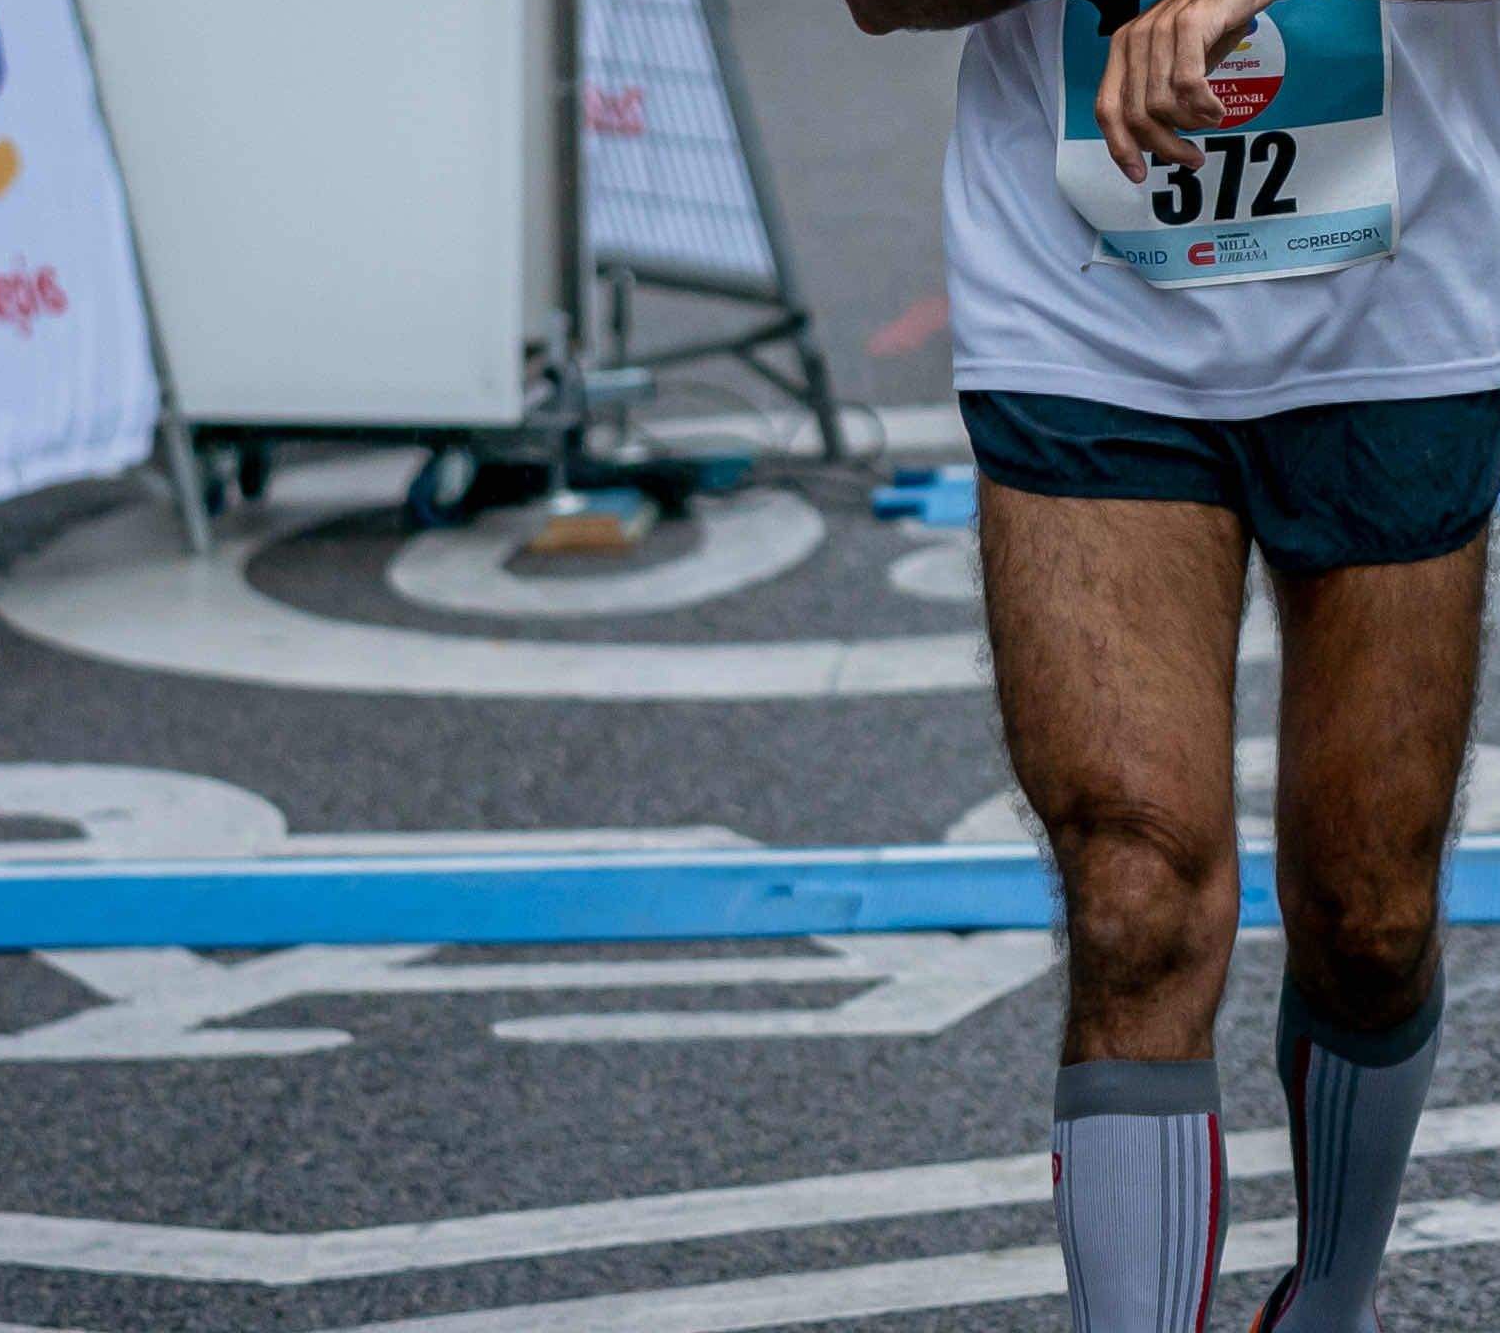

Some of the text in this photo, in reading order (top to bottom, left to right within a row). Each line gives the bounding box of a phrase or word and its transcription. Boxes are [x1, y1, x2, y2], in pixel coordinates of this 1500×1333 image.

[1151, 130, 1298, 225] 372
[1217, 237, 1260, 251] MILLA
[1219, 250, 1268, 263] URBANA
